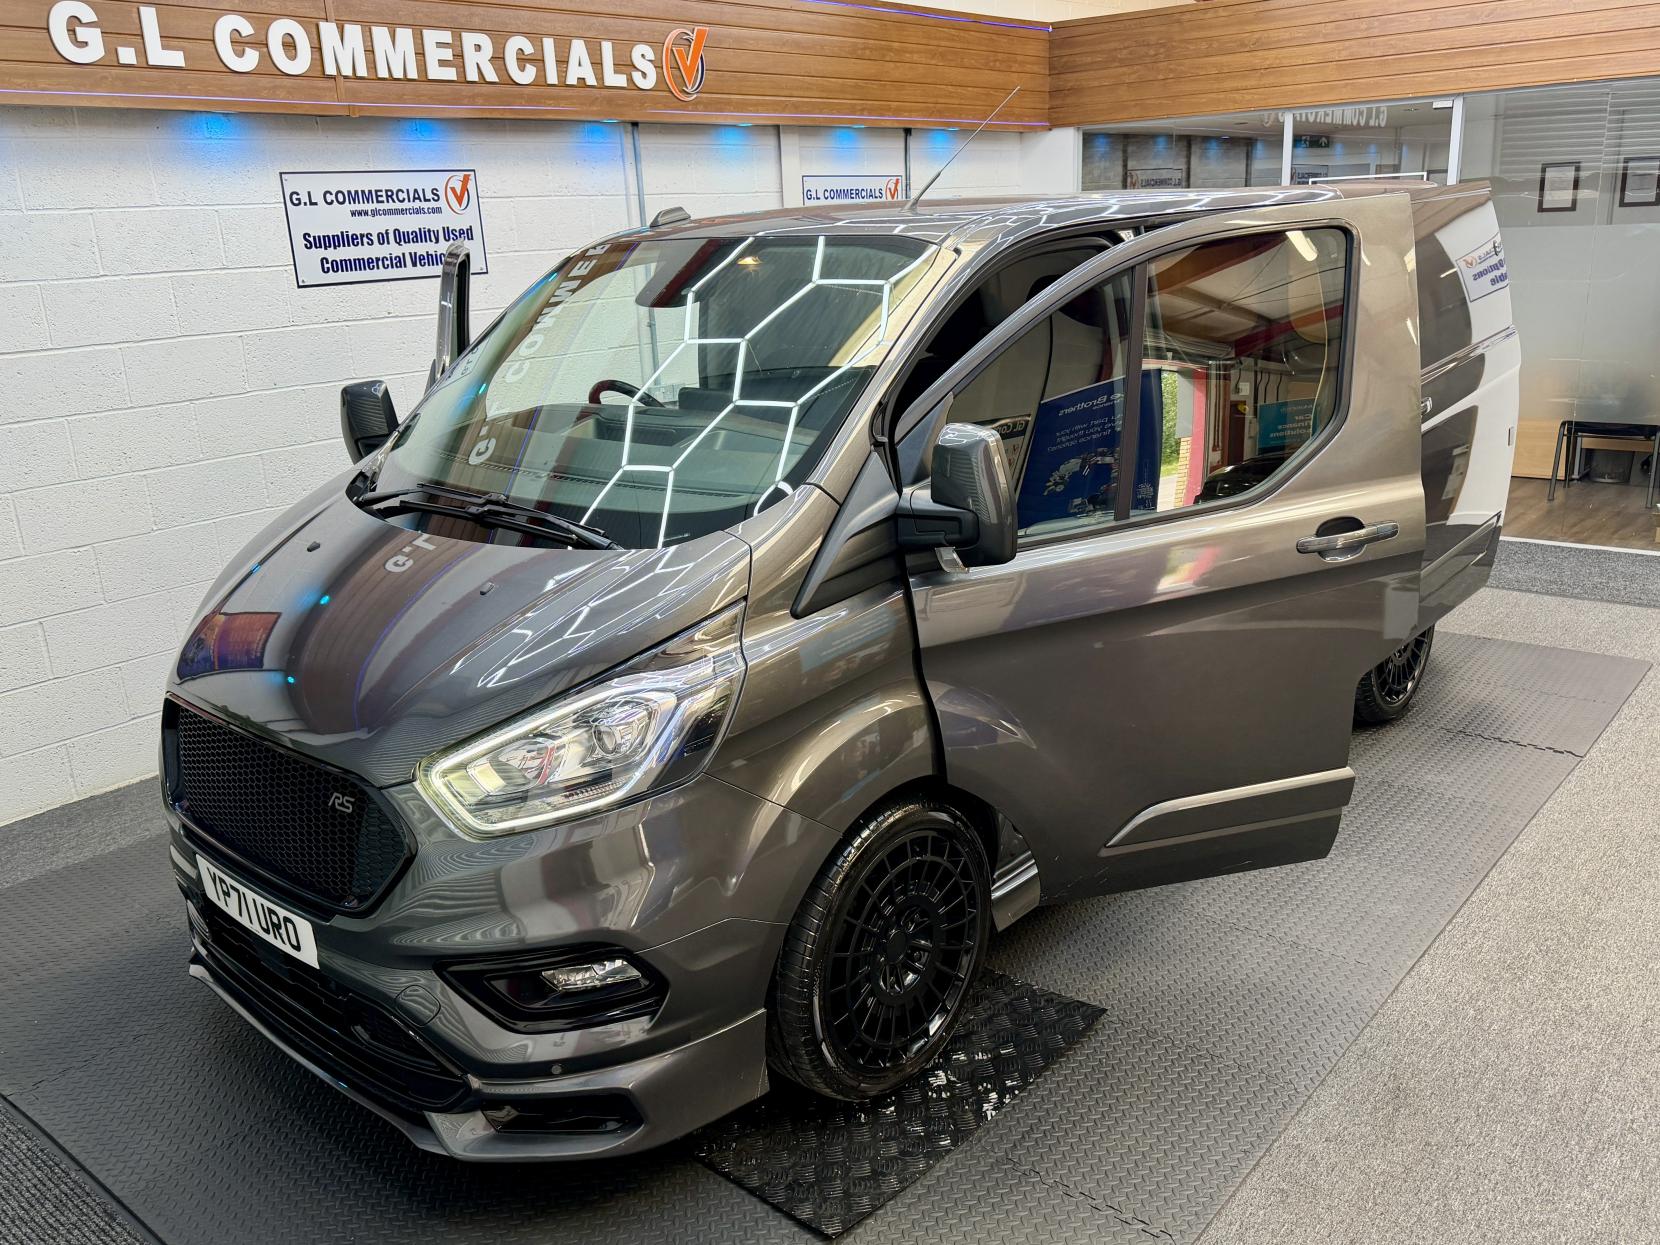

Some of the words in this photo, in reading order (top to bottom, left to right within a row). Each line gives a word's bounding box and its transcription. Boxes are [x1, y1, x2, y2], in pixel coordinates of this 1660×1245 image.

[47, 0, 186, 68] G.L
[213, 14, 657, 91] COMMERCIALS
[289, 190, 318, 207] G.L
[322, 187, 441, 206] COMMERCIALS
[806, 189, 821, 201] G.L
[823, 188, 884, 200] COMMERCIALS
[350, 206, 443, 218] www.glcommercials.com
[302, 230, 375, 251] Suppliers
[376, 228, 391, 246] of
[393, 226, 441, 246] Quality
[442, 225, 474, 242] Used
[320, 253, 407, 274] Commercial
[409, 250, 446, 269] Vehic
[328, 792, 356, 814] RS
[206, 866, 255, 927] YP71
[253, 899, 303, 953] URO
